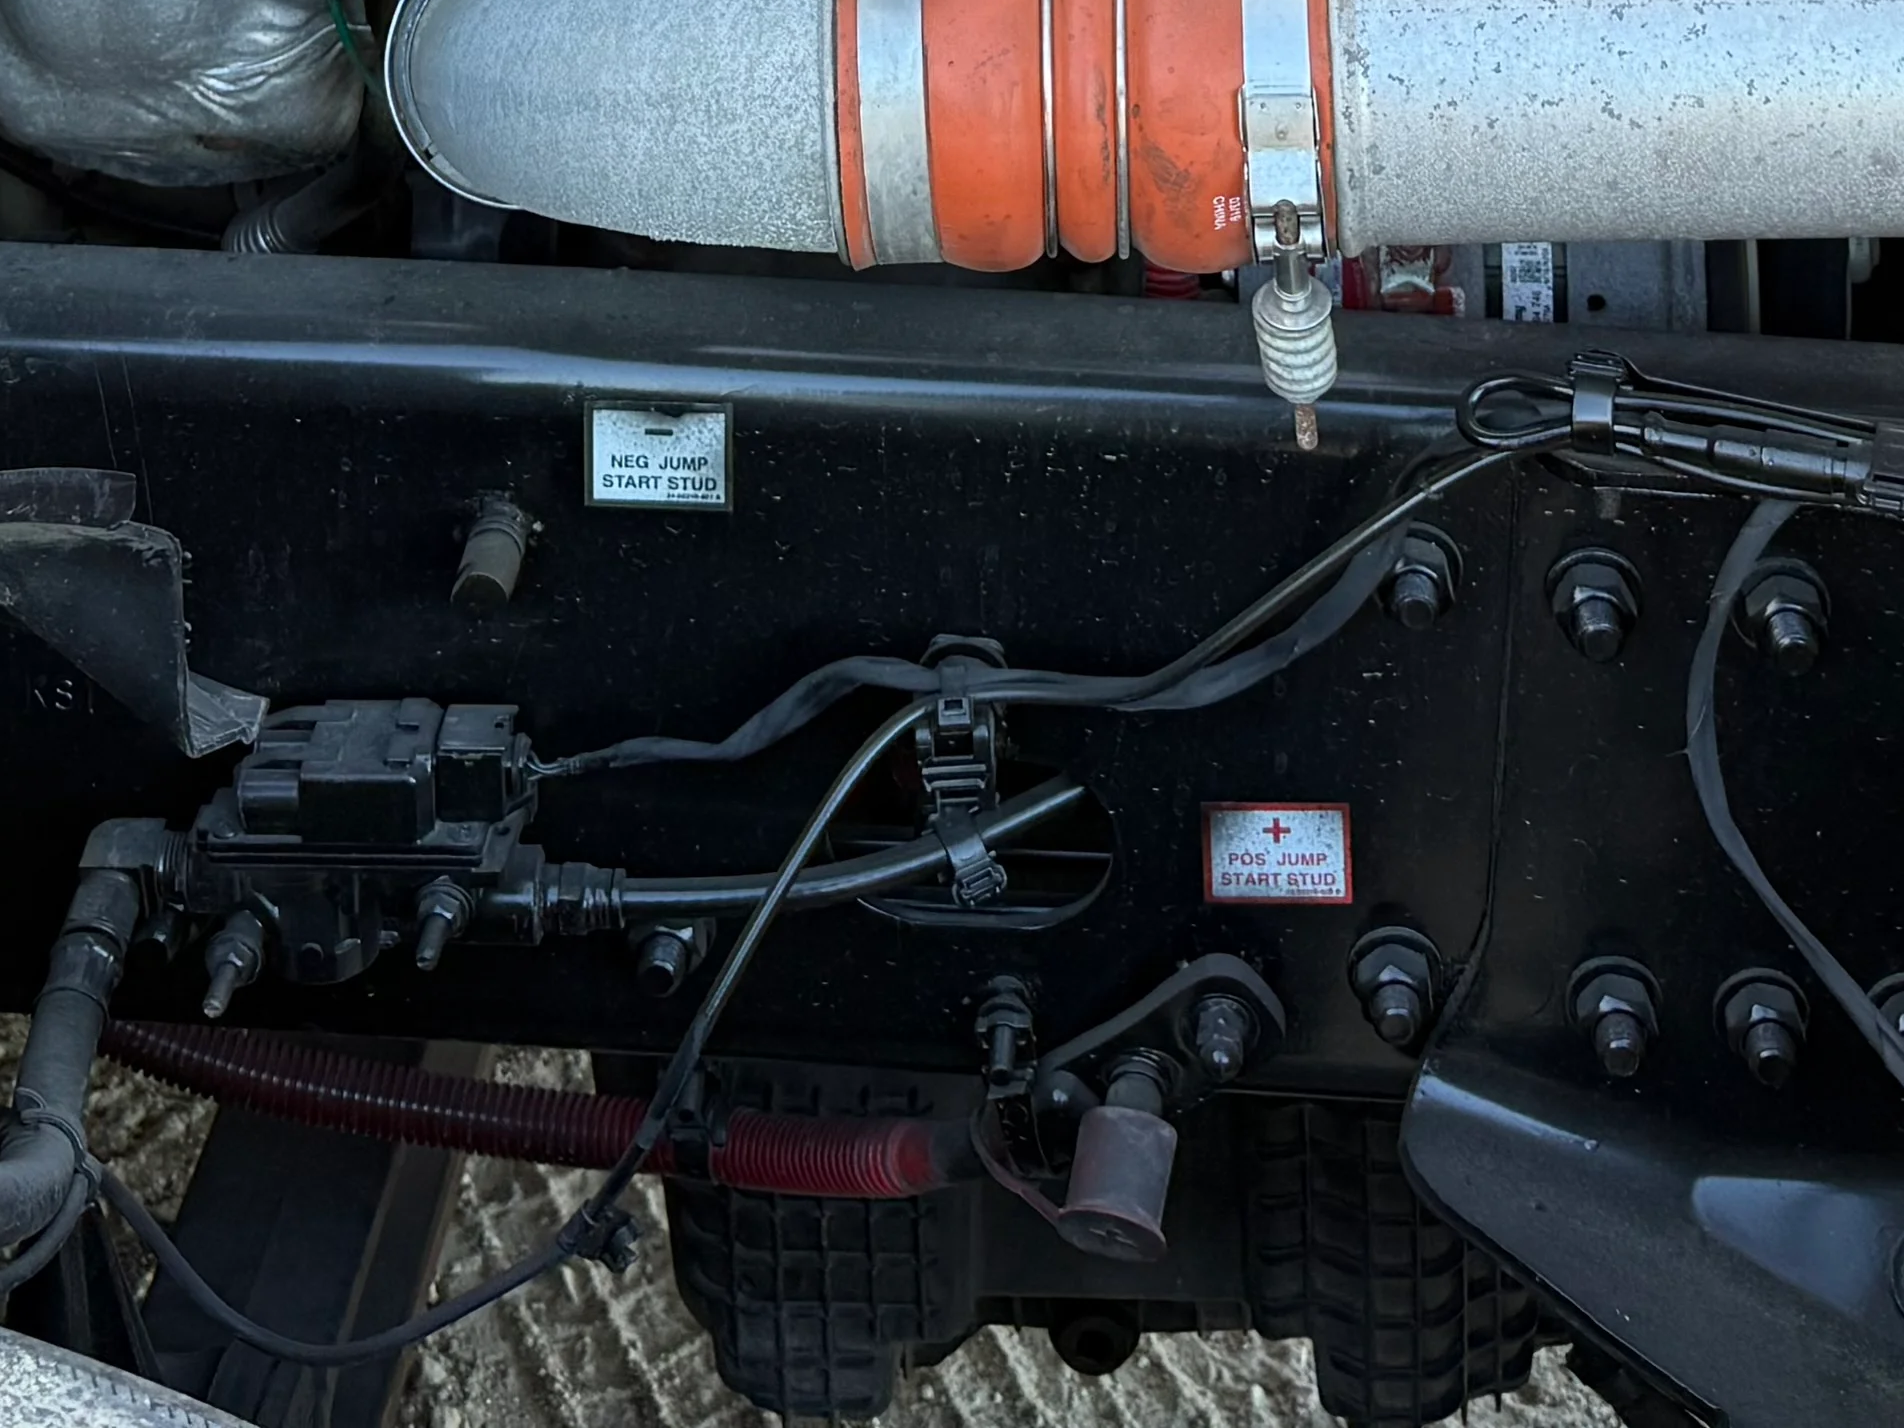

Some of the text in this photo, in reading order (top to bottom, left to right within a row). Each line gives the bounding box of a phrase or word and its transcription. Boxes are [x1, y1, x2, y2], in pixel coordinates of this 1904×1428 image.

[1213, 195, 1227, 231] CHINA
[611, 454, 709, 471] NEG JUMP
[602, 474, 717, 492] START STUD
[1228, 852, 1328, 866] POS JUMP
[1221, 872, 1336, 887] START STUD
